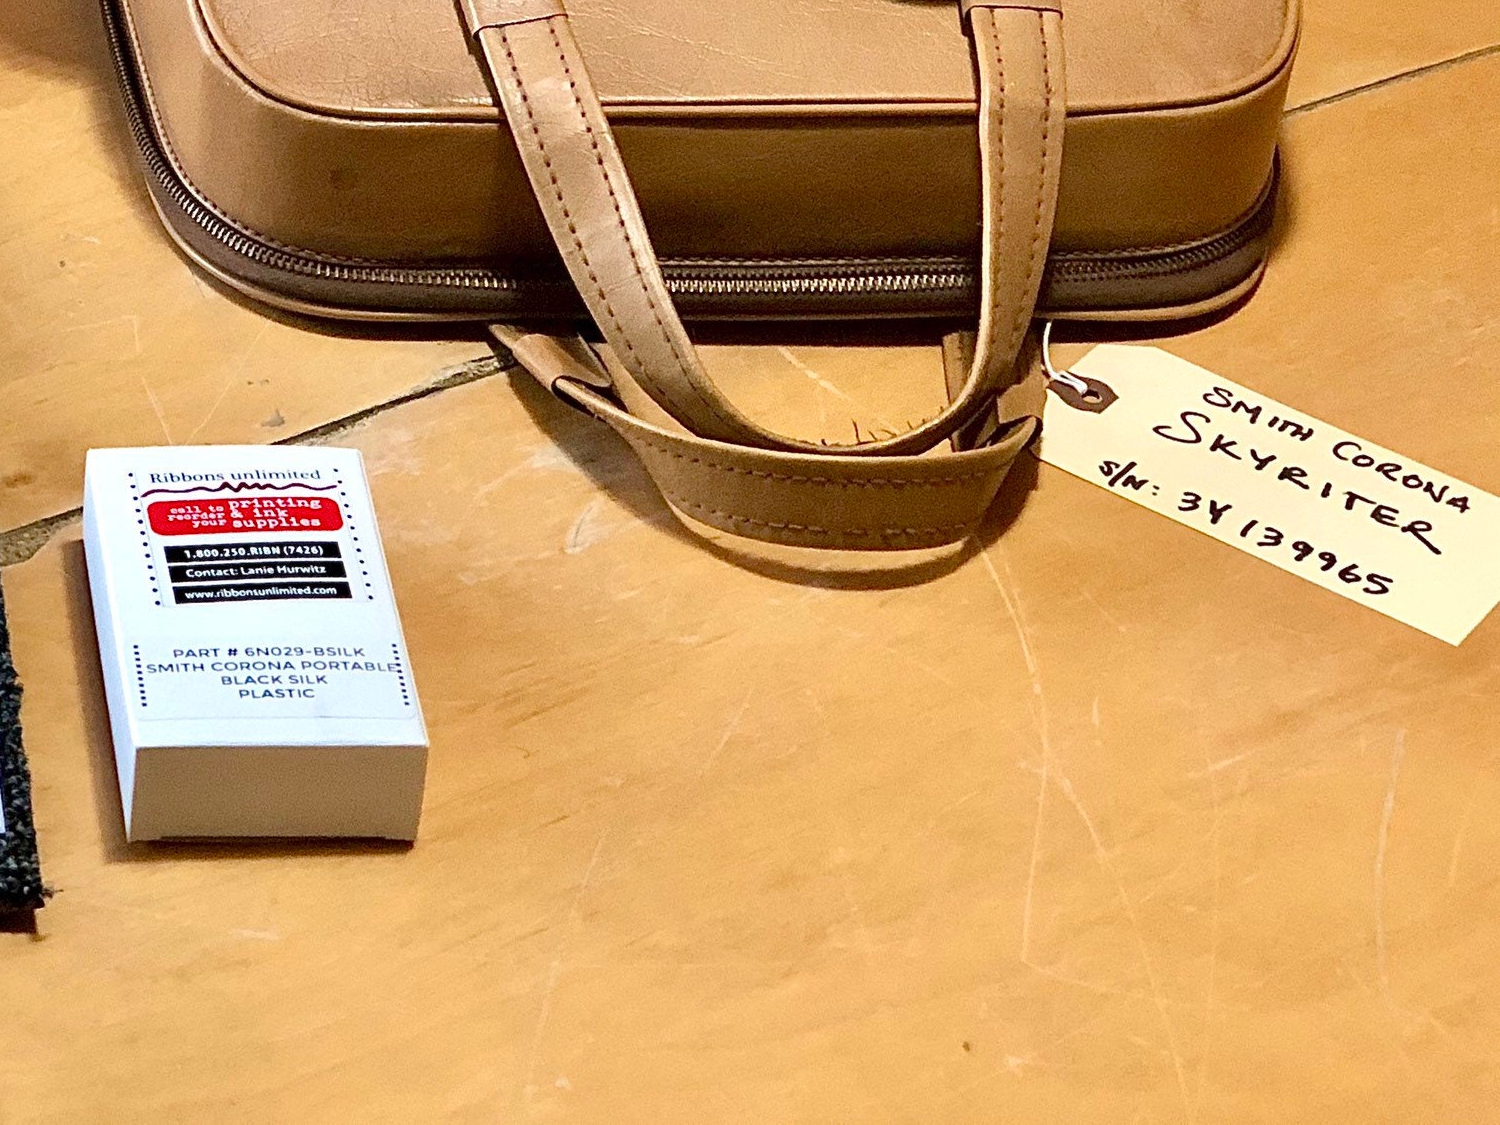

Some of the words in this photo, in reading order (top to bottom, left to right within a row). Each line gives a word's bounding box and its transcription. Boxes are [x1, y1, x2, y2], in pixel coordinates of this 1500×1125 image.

[1202, 385, 1314, 442] SMITH
[1332, 440, 1471, 514] CORONA
[150, 472, 225, 483] Ribbons
[230, 469, 321, 481] unlimited
[1152, 411, 1442, 555] SKYRITER
[169, 505, 202, 514] call
[208, 504, 225, 512] to
[227, 498, 323, 511] printing
[167, 512, 226, 521] reorder
[230, 508, 244, 518] &
[253, 508, 289, 518] ink
[192, 519, 227, 528] your
[232, 517, 321, 529] supplies
[283, 545, 324, 557] (7426)
[185, 568, 239, 578] Contact:
[240, 566, 275, 576] Lanie
[276, 564, 327, 574] Hurwitz
[184, 586, 338, 600] www.ribbonsunlimited.com
[173, 647, 221, 658] PART
[227, 647, 239, 657] #
[245, 646, 366, 658] 6N029-BSILK
[146, 662, 205, 674] SMITH
[210, 661, 296, 673] CORONA
[301, 660, 399, 672] PORTABLE
[221, 674, 283, 686] BLACK
[287, 674, 328, 685] SILK
[238, 688, 316, 700] PLASTIC
